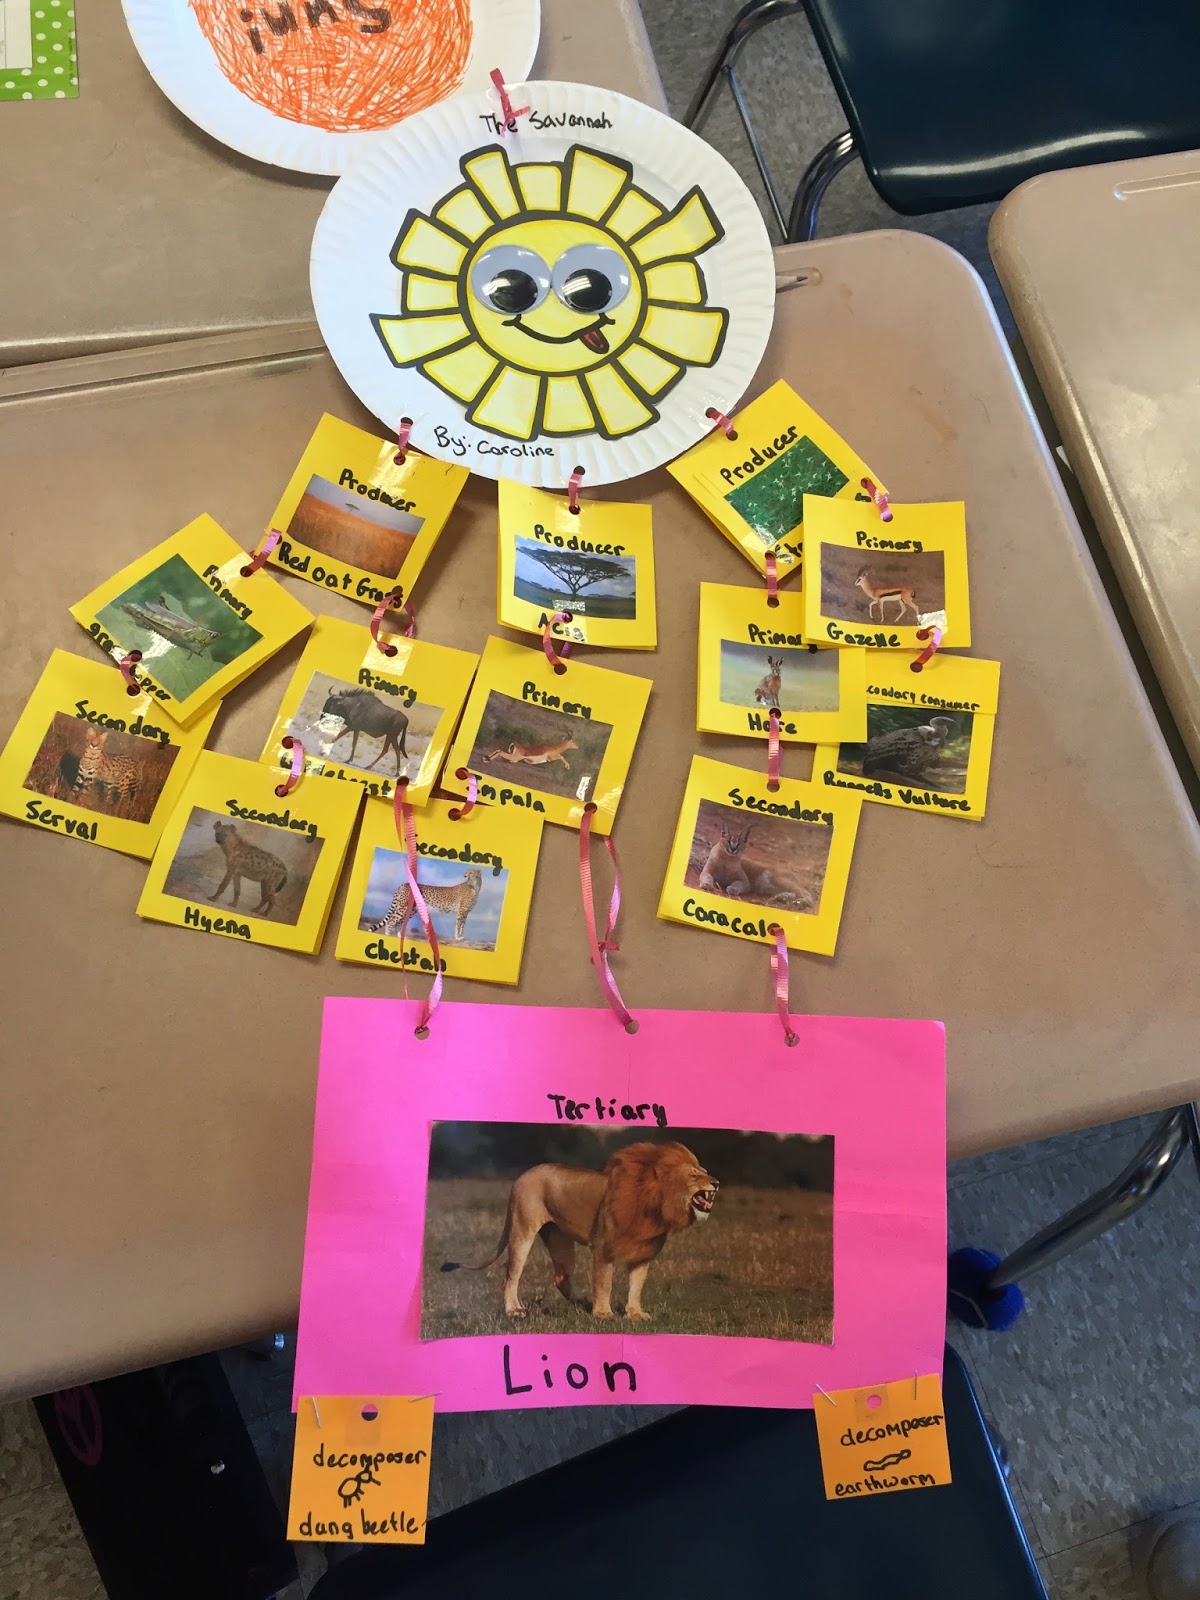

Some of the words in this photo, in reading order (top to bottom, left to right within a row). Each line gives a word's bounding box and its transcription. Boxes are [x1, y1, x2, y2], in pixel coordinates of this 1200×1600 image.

[480, 112, 518, 136] The
[528, 111, 613, 130] Savannah
[433, 425, 472, 456] By:
[477, 440, 555, 457] Caroline
[720, 425, 799, 486] Producer
[338, 468, 417, 513] Producer
[534, 524, 626, 556] Producer
[856, 531, 923, 554] Primary
[278, 541, 312, 573] Red
[311, 566, 353, 591] Oat
[202, 564, 253, 621] Primary
[826, 622, 901, 648] Gazelle
[358, 668, 418, 709] Primary
[522, 681, 592, 720] Primary
[75, 700, 171, 750] Secondary
[728, 788, 834, 826] Secondary
[898, 789, 972, 812] Vulture
[25, 800, 98, 841] Serval
[225, 799, 318, 844] Secondary
[184, 906, 251, 940] Hyena
[683, 898, 767, 938] Caracal
[547, 1093, 668, 1128] Tertiary
[503, 1344, 637, 1396] Lion
[841, 1414, 944, 1447] decomposer
[313, 1442, 427, 1472] decomposer
[834, 1474, 936, 1497] earthworm
[299, 1511, 354, 1540] dung
[361, 1508, 419, 1536] beetle
